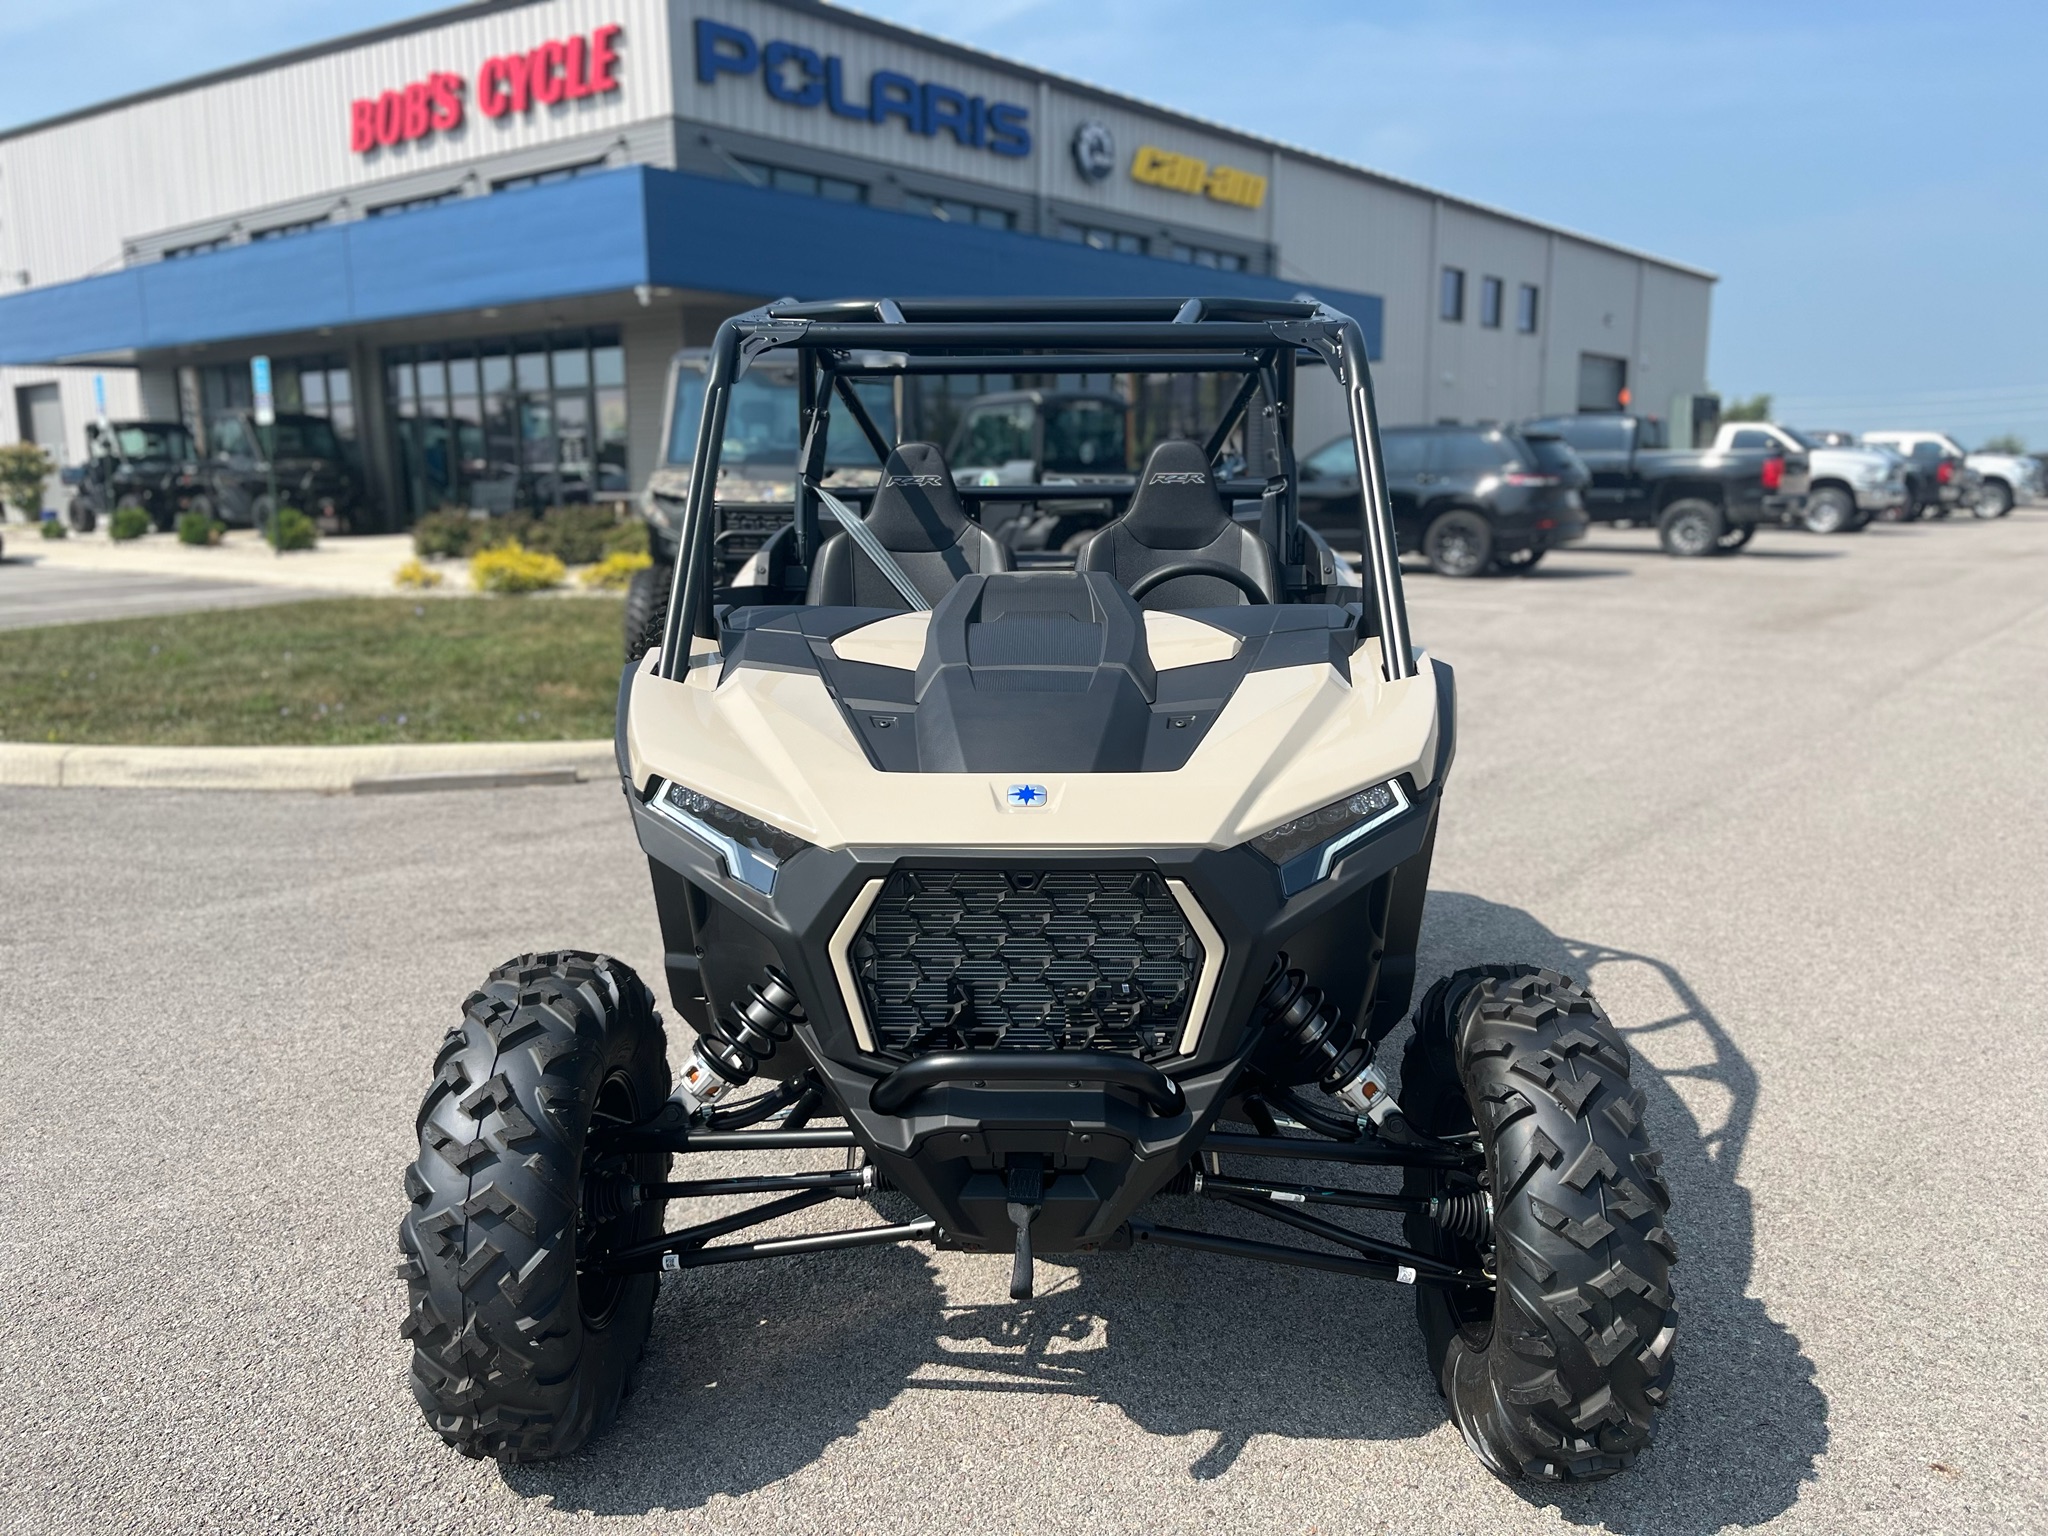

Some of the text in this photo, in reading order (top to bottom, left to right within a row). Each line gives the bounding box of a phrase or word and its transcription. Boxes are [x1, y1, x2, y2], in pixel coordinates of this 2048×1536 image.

[351, 23, 621, 153] BOB'S CYCLE
[695, 18, 1032, 158] POLARIS
[885, 474, 942, 488] RZR
[1149, 472, 1206, 485] RZR
